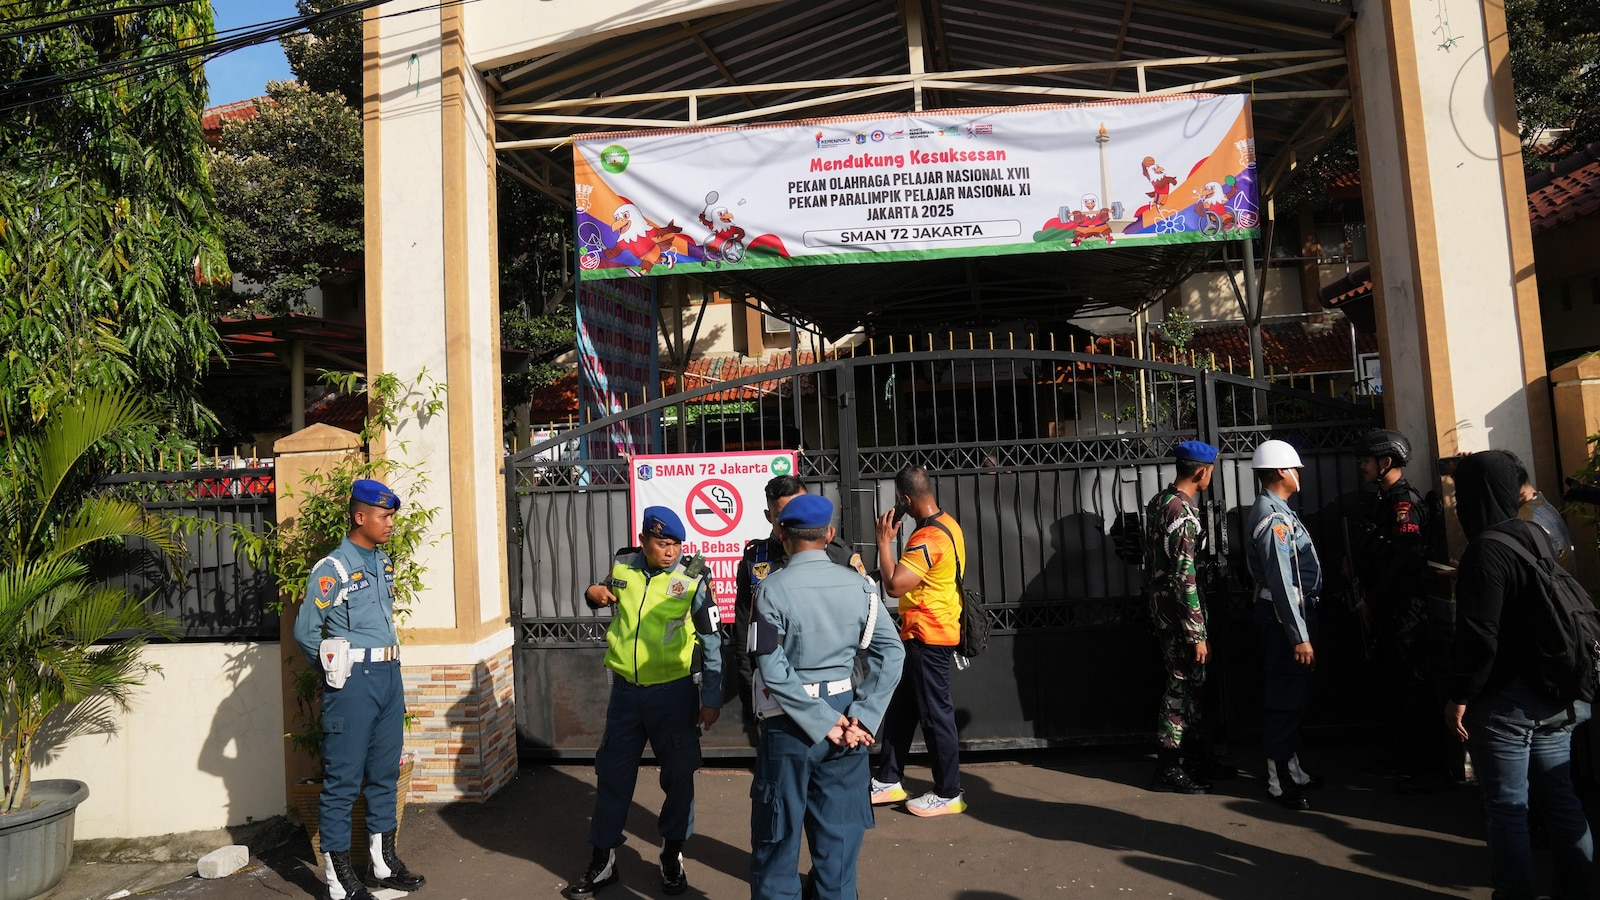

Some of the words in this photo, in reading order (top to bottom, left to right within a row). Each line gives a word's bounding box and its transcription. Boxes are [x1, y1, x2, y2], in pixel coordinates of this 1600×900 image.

[810, 153, 905, 173] Mendukung
[909, 147, 1007, 165] Kesuksesan
[788, 178, 827, 194] PEKAN
[829, 173, 891, 190] OLAHRAGA
[893, 171, 943, 186] PELAJAR
[946, 168, 1004, 183] NASIONAL
[1006, 166, 1030, 180] XVII
[788, 194, 828, 210] PEKAN
[830, 189, 902, 207] PARALIMPIK
[904, 187, 955, 202] PELAJAR
[957, 184, 1016, 199] NASIONAL
[1018, 183, 1031, 196] XI
[867, 206, 919, 221] JAKARTA
[921, 203, 955, 219] 2025
[840, 229, 887, 243] SMAN
[890, 228, 908, 240] 72
[912, 224, 984, 239] JAKARTA
[655, 463, 695, 477] SMAN
[699, 462, 716, 475] 72
[720, 461, 768, 475] Jakarta
[701, 540, 740, 554] Bebas
